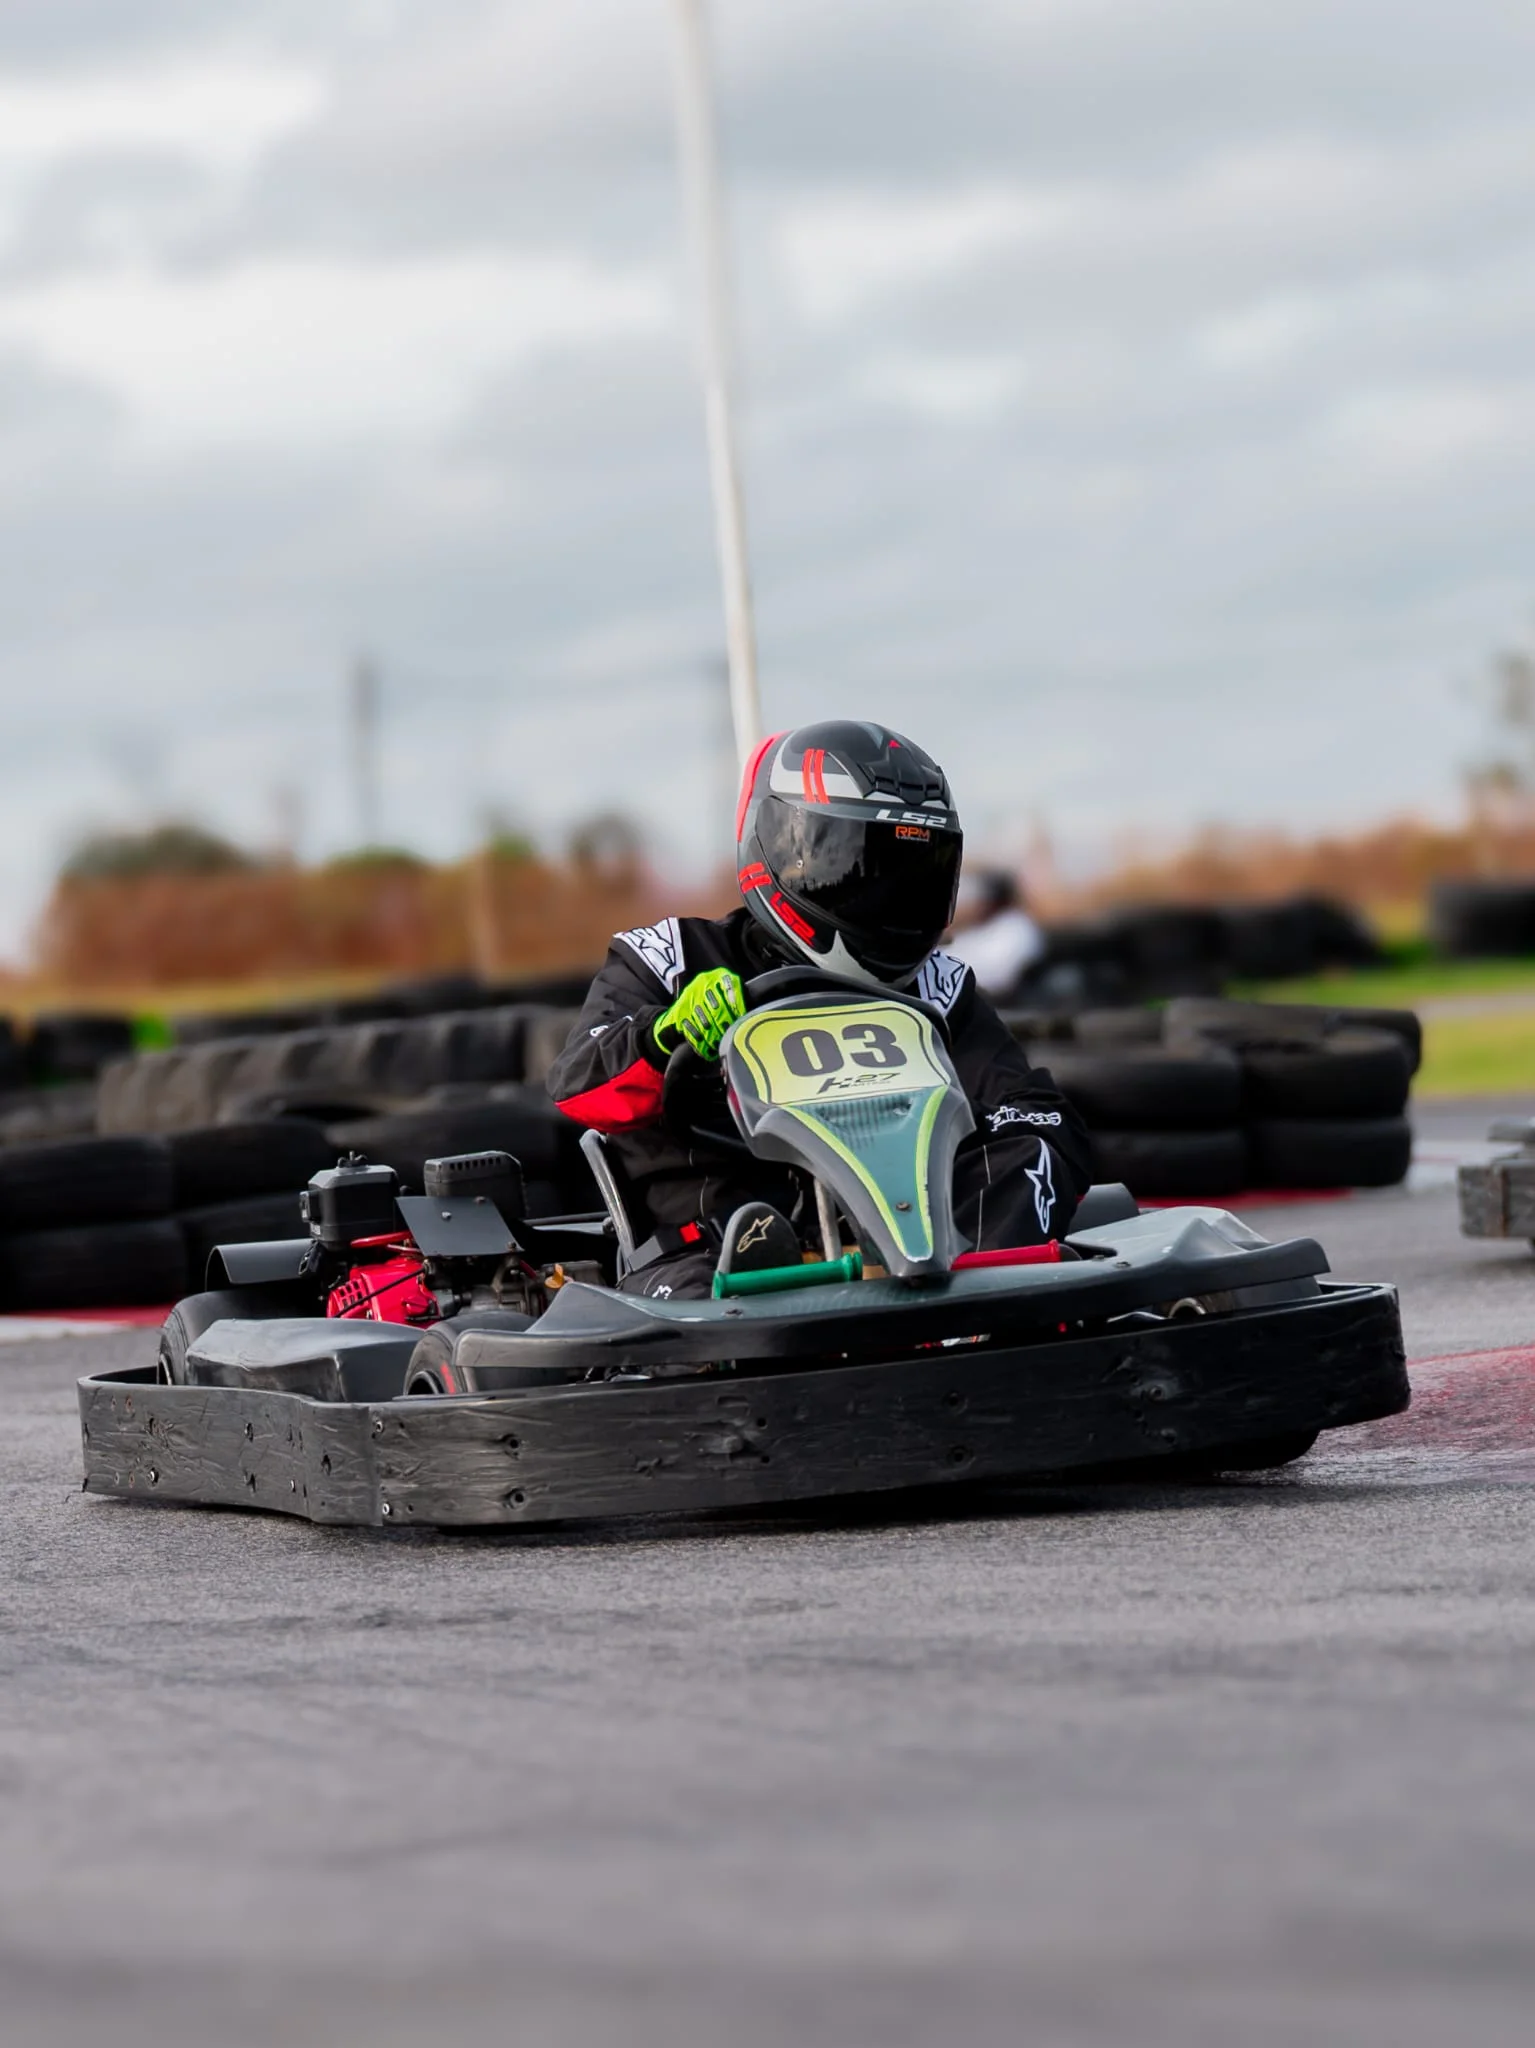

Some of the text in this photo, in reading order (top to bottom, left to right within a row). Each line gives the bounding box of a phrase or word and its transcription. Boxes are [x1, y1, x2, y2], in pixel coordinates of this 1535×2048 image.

[875, 809, 947, 828] LS2
[895, 825, 930, 838] RPM
[769, 891, 816, 948] LS2
[781, 1023, 908, 1077] 03
